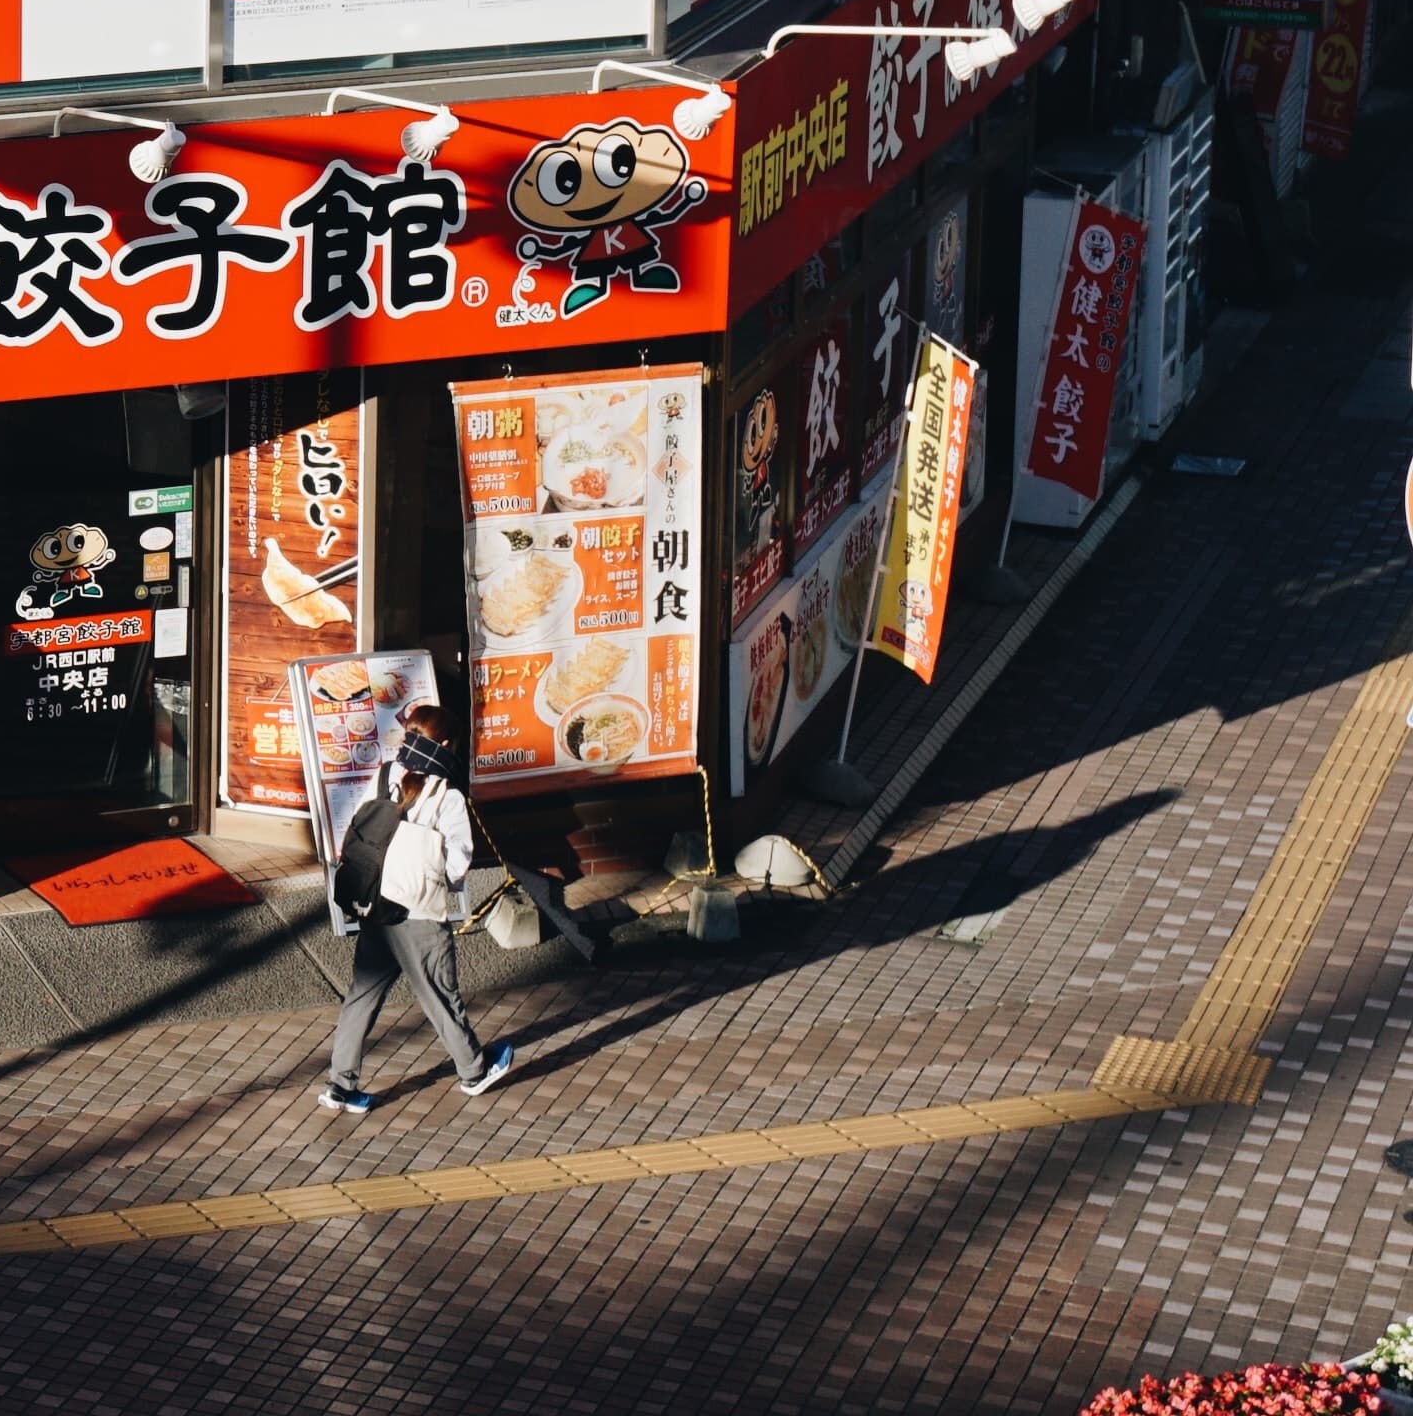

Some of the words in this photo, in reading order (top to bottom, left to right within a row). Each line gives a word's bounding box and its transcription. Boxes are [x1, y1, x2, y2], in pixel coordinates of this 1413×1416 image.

[739, 78, 848, 236] 駅前中央店
[604, 226, 625, 255] K
[500, 306, 553, 324] 健太くん
[1045, 275, 1102, 464] 健太餃子
[909, 363, 946, 522] 全国発送
[602, 547, 639, 563] セット
[653, 529, 689, 624] 朝食
[10, 618, 142, 650] 宇都宮餃子館
[33, 647, 115, 670] JR西口駅前
[39, 667, 108, 692] 中央店
[53, 862, 199, 892] いらっしゃいませ
